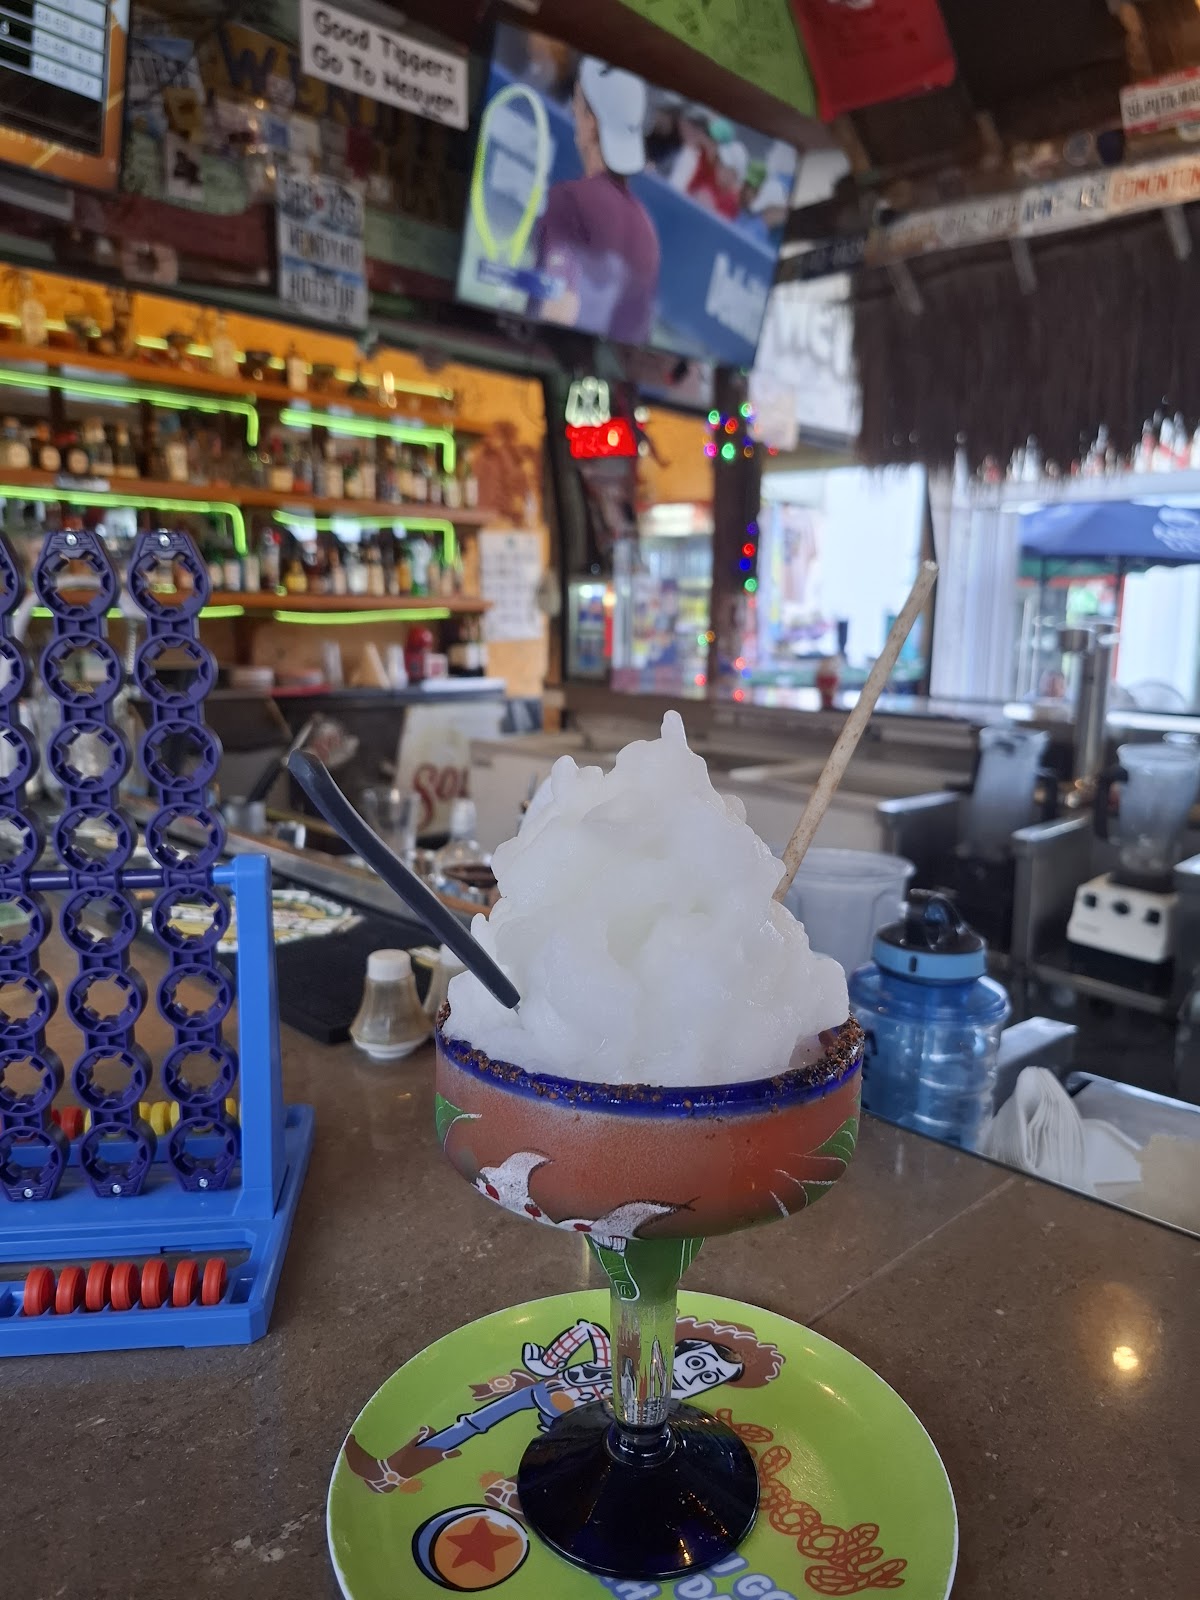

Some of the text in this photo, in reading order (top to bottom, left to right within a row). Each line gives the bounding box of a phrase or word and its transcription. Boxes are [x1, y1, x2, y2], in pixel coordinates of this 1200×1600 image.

[312, 44, 460, 117] Go To Heaven
[313, 10, 457, 84] Good Tippers
